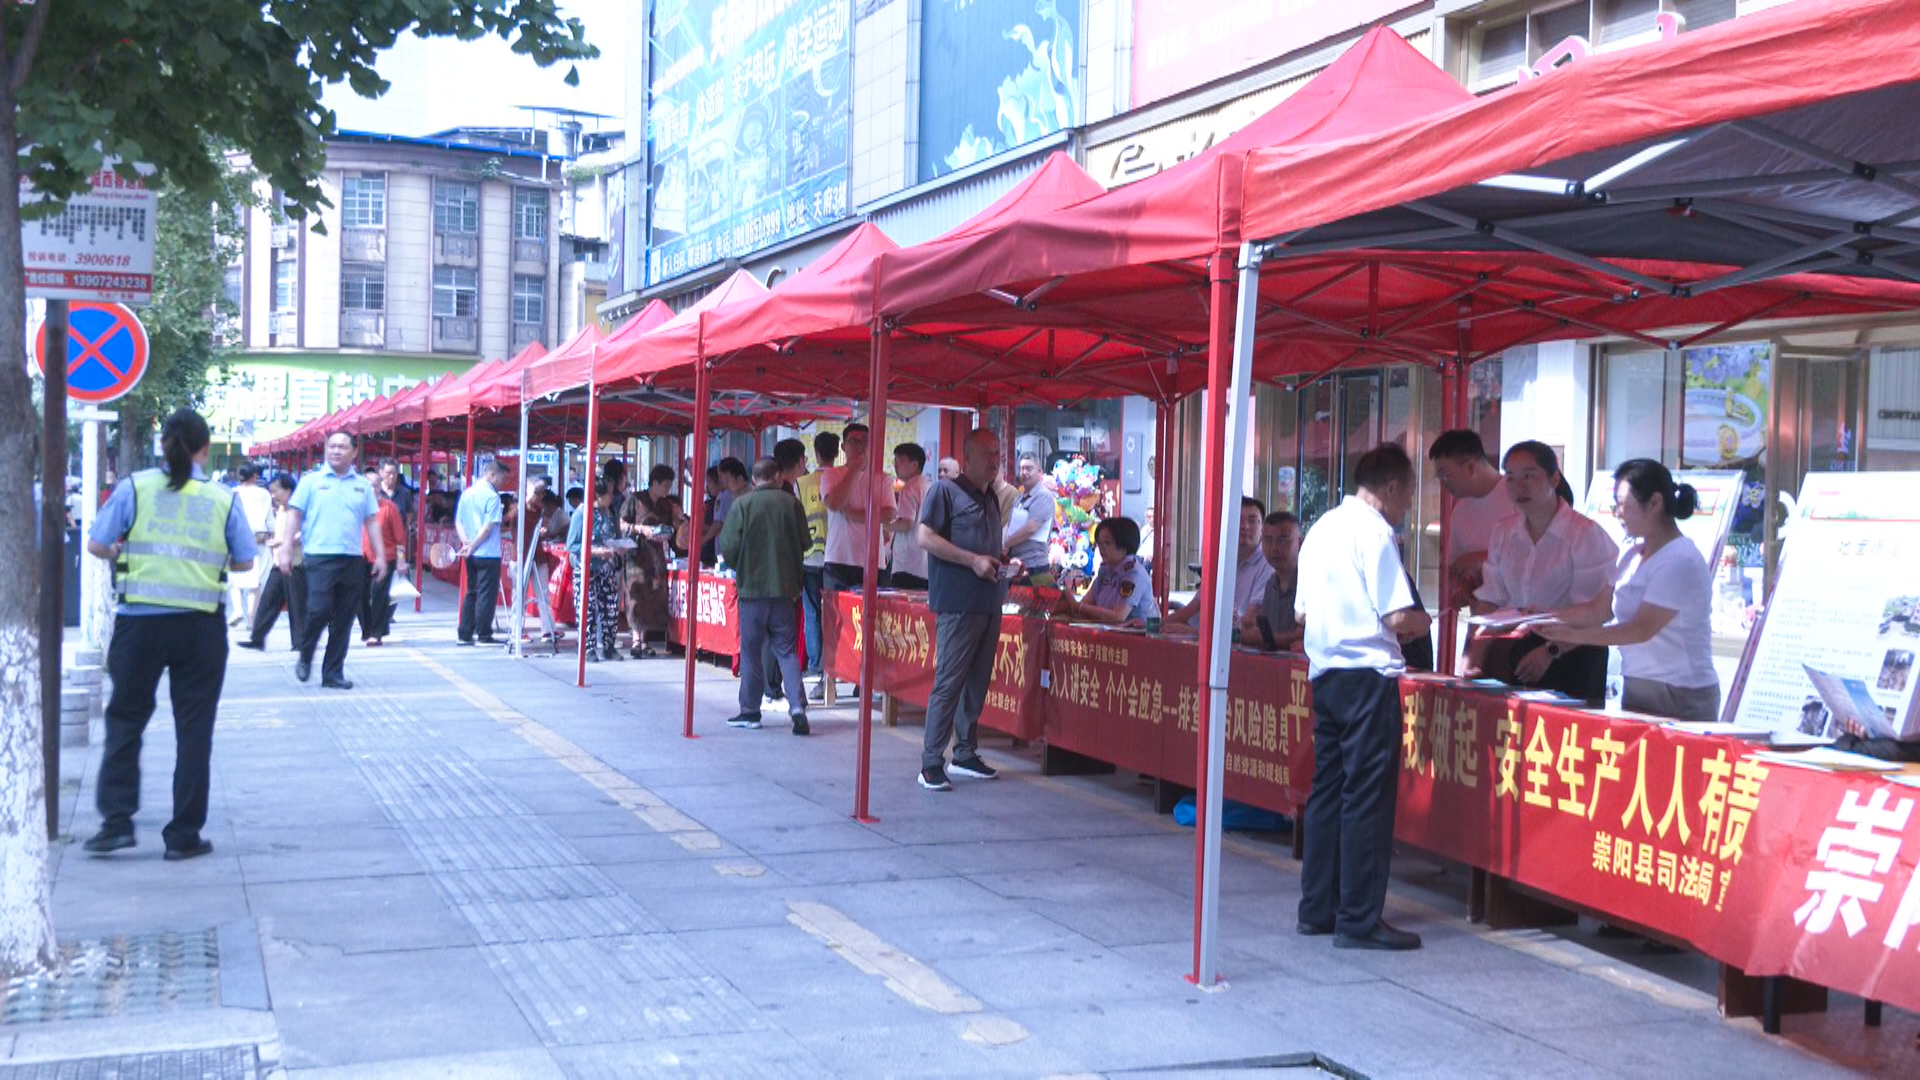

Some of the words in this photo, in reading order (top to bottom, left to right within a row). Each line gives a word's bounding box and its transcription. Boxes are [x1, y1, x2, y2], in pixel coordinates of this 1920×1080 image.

[73, 274, 147, 289] 13907243238
[75, 253, 131, 267] 3900618
[147, 519, 211, 541] POLICE
[668, 578, 727, 627] 阳县通运输局
[1050, 660, 1100, 710] 人人讲安全
[1494, 711, 1770, 865] 安全生产人人有责
[1591, 830, 1715, 907] 崇阳县司法局
